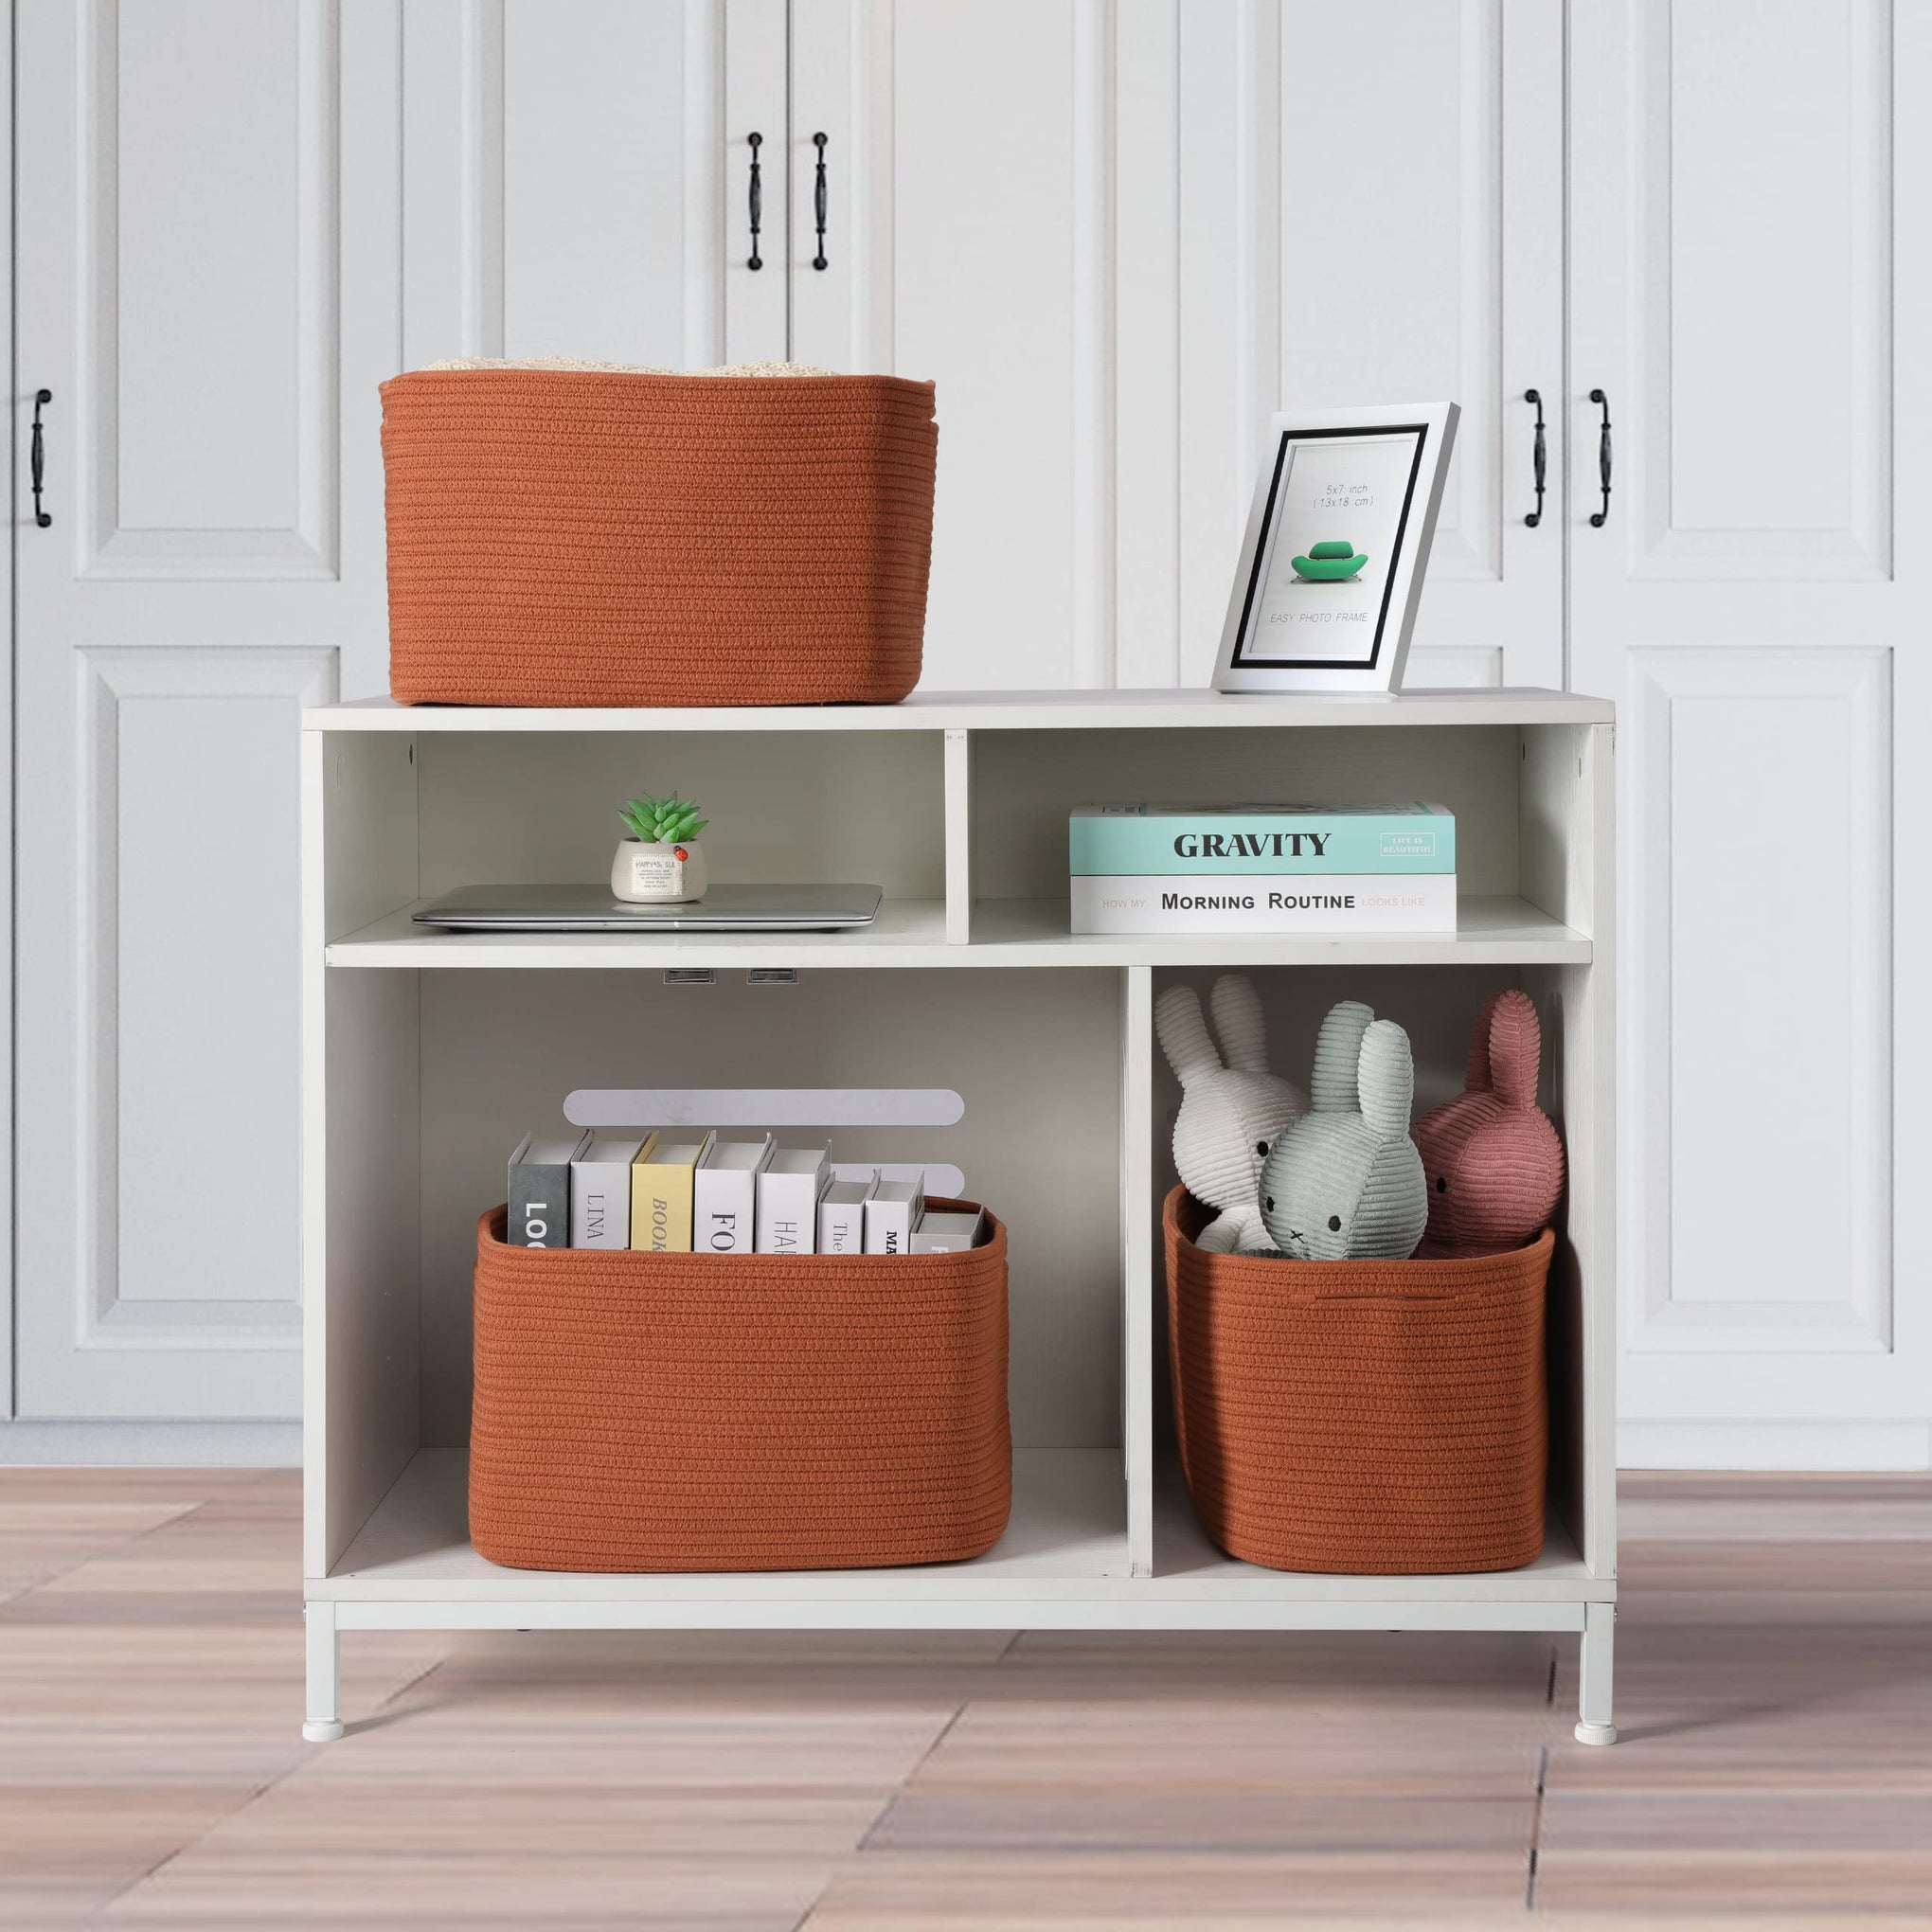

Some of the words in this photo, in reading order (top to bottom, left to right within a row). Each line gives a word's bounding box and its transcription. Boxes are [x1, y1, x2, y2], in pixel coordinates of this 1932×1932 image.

[1350, 484, 1368, 493] inch
[1270, 613, 1295, 623] EASY
[1299, 613, 1332, 623] PHOTO
[1336, 613, 1368, 622] FRAME
[1173, 832, 1332, 857] GRAVITY
[1102, 899, 1127, 908] HOW
[1130, 899, 1146, 908] MY
[1362, 898, 1399, 906] LOOKS
[1402, 897, 1425, 906] LIKE
[587, 1194, 604, 1239] LINA
[710, 1212, 735, 1251] FO
[833, 1223, 849, 1251] The
